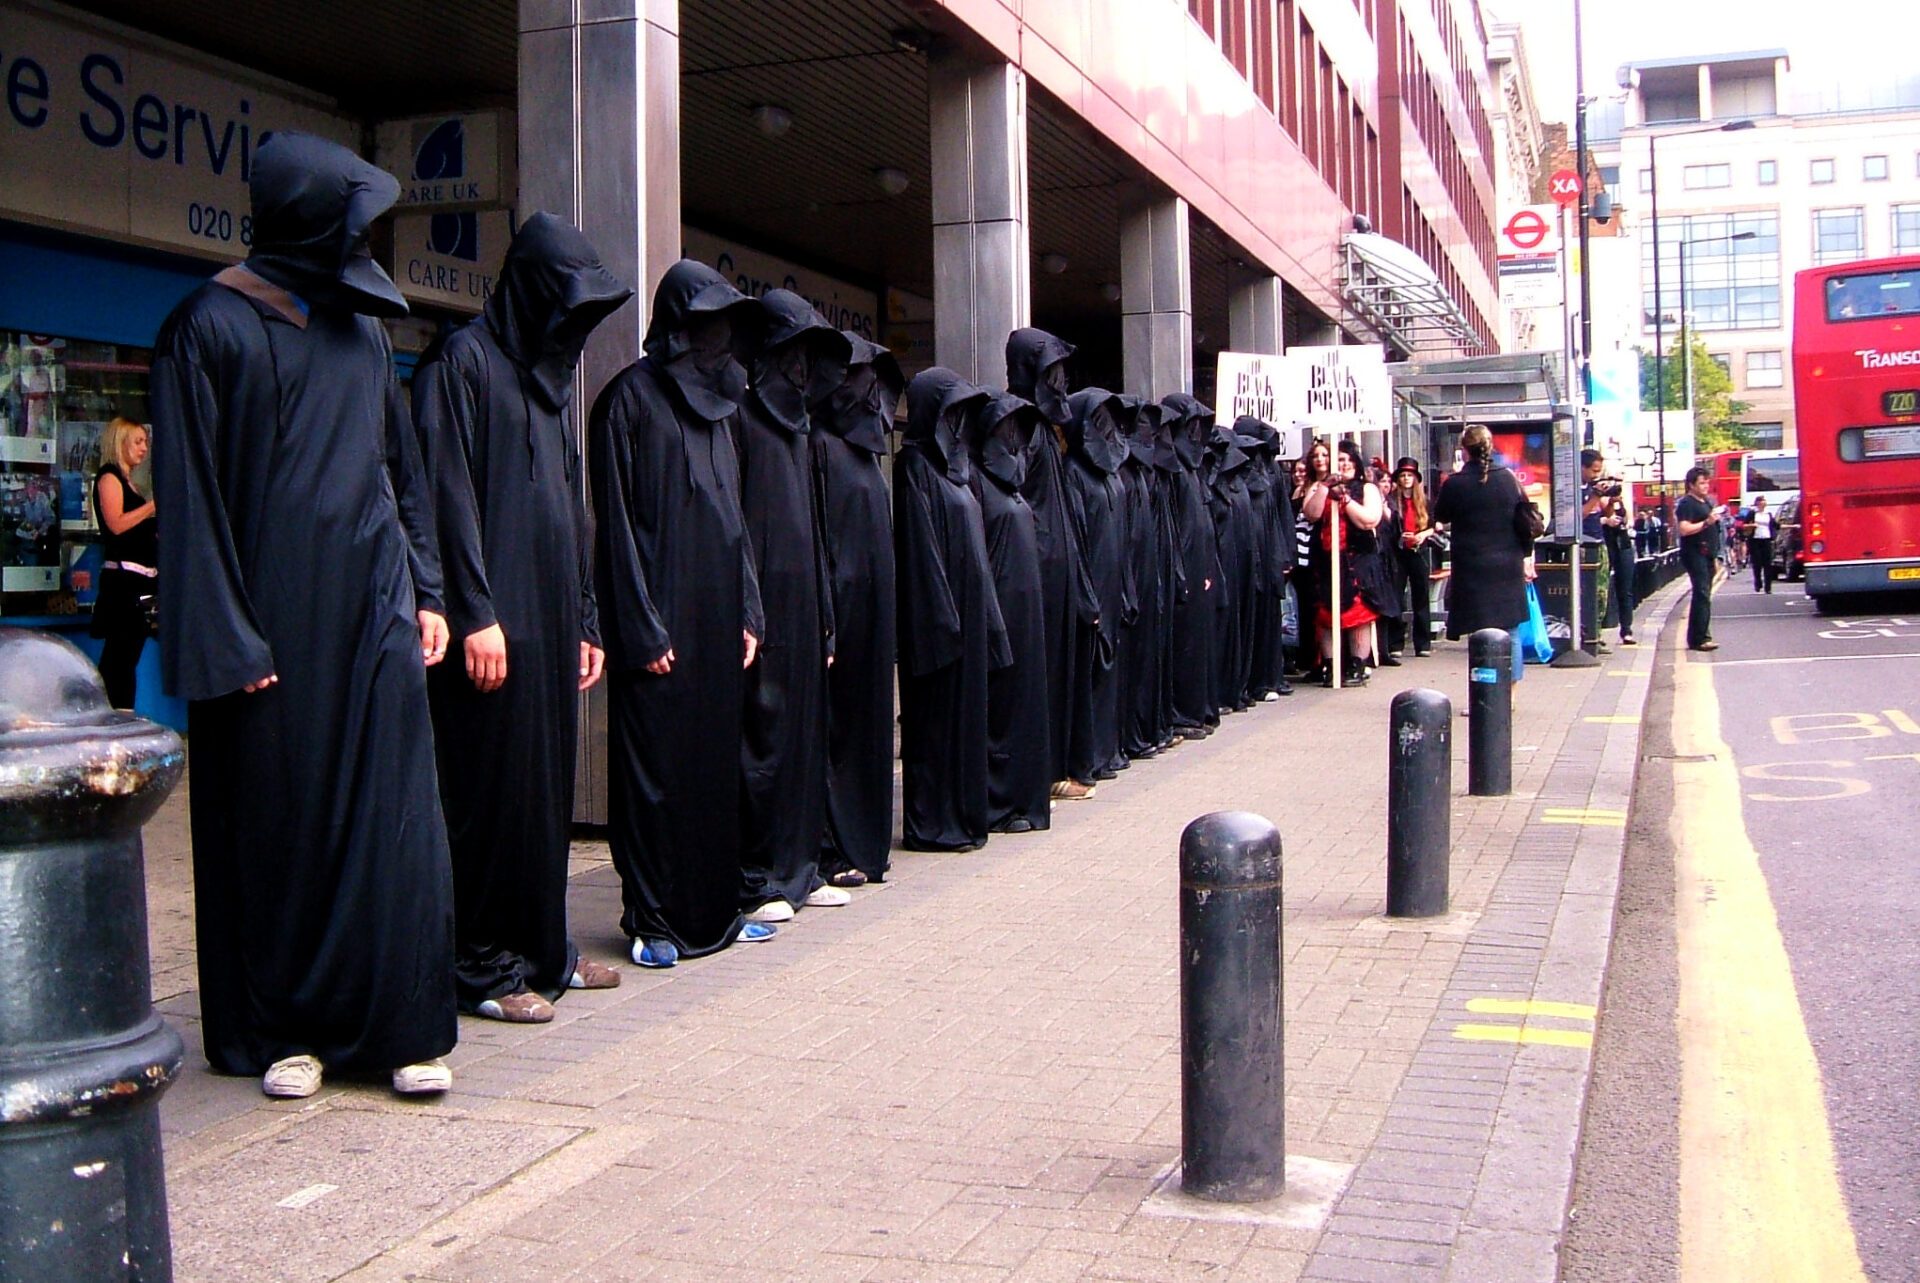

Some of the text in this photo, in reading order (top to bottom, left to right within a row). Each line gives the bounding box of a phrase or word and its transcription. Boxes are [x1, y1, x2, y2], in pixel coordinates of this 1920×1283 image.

[0, 50, 273, 182] e Servi
[397, 183, 479, 203] ARE UK
[1552, 178, 1579, 194] XA
[188, 203, 231, 241] 020
[409, 259, 495, 298] CARE UK
[1889, 393, 1916, 412] 220
